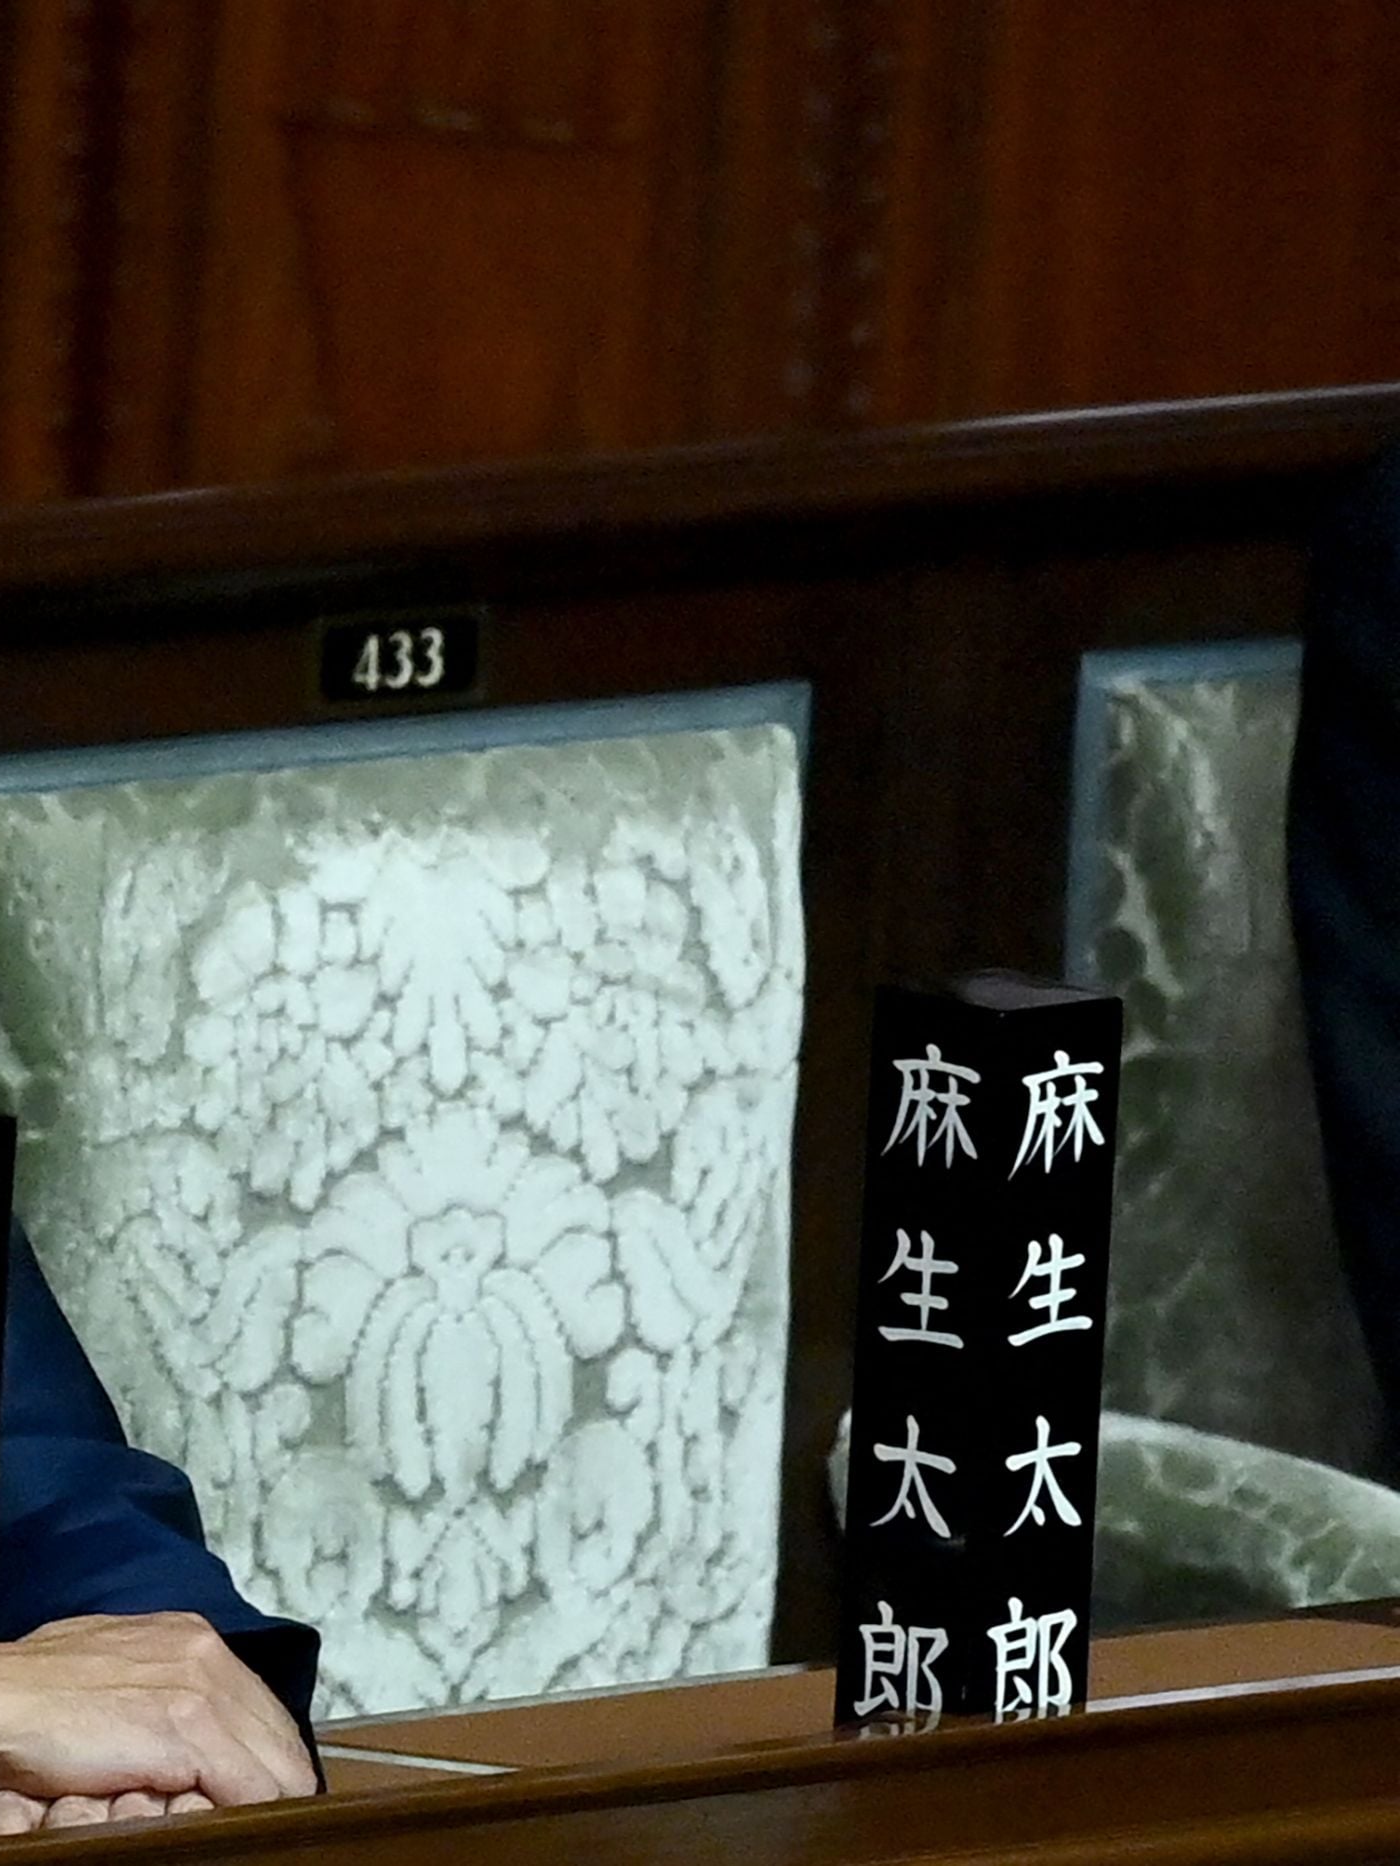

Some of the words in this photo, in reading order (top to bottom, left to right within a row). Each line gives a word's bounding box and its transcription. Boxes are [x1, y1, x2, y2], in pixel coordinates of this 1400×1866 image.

[352, 626, 445, 691] 433
[853, 1043, 982, 1720] 麻生太郎
[986, 1049, 1106, 1721] 麻生太郎
